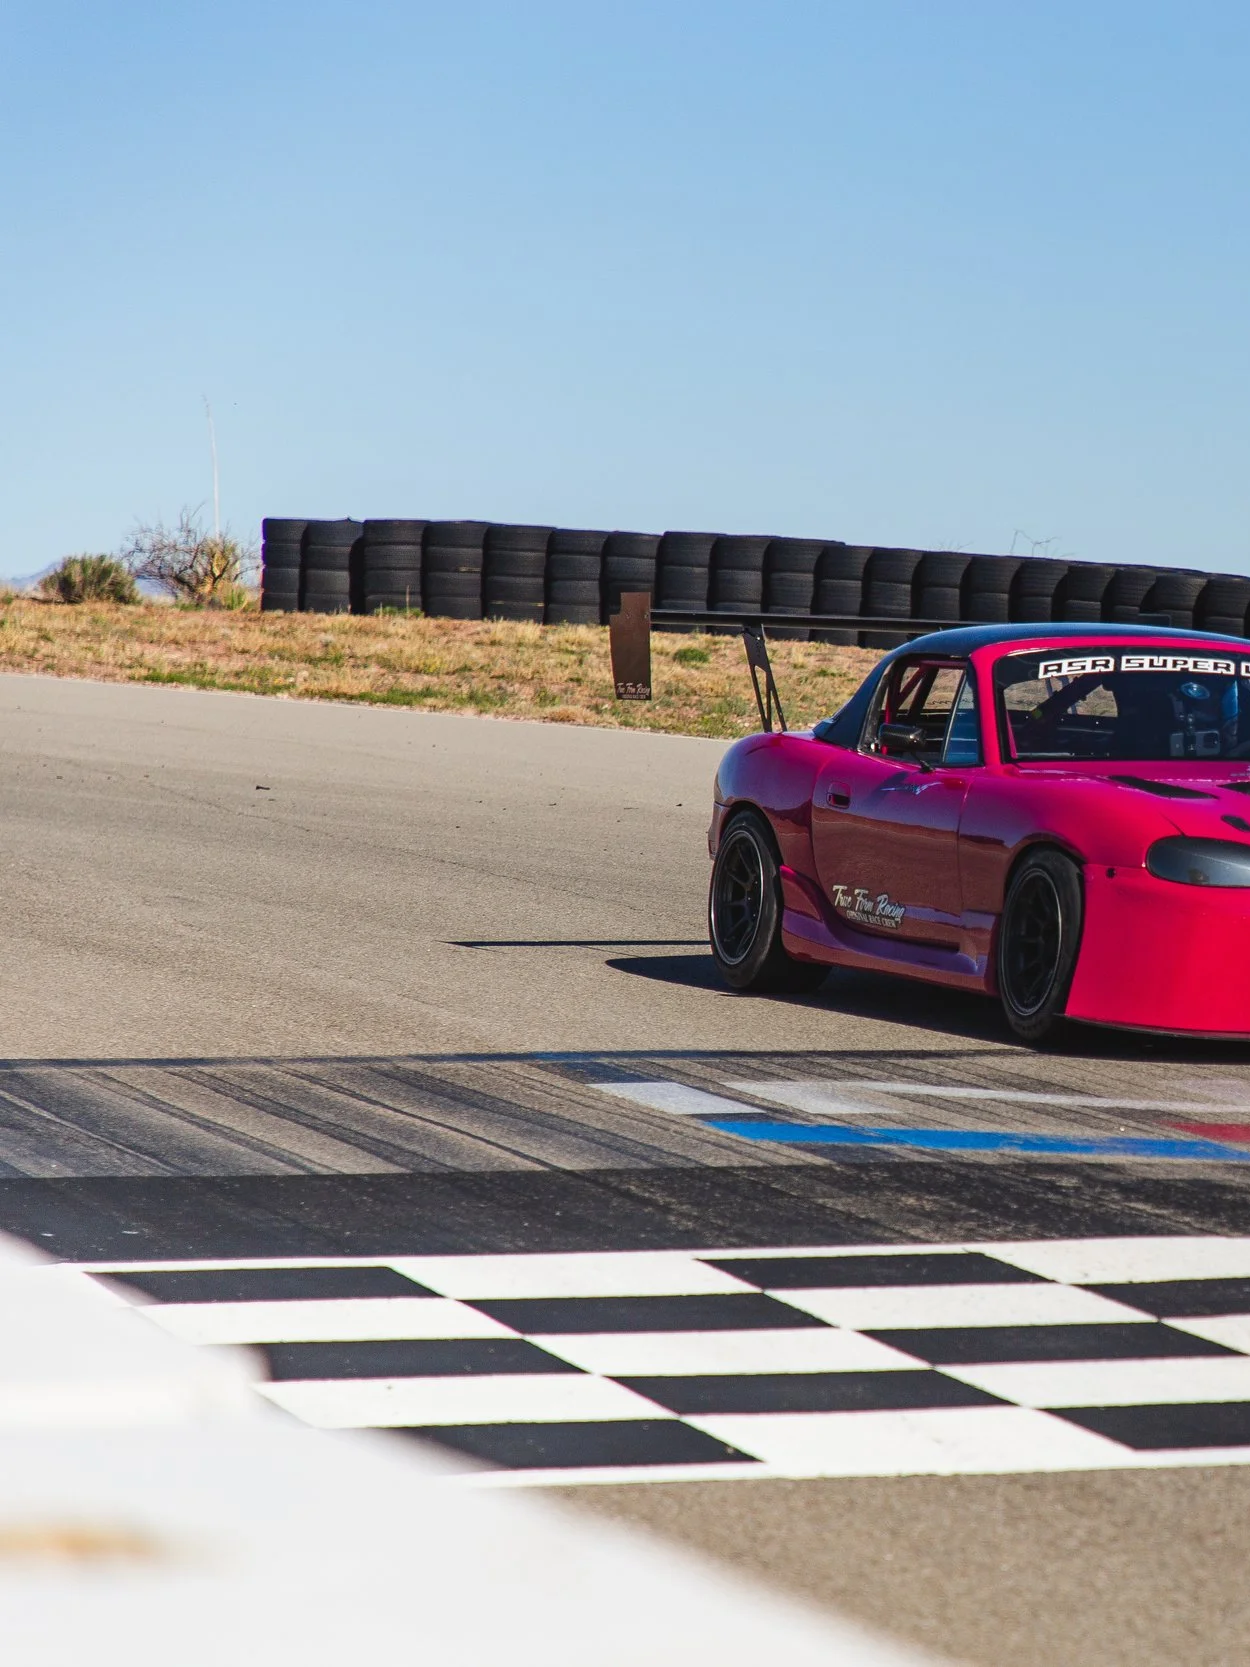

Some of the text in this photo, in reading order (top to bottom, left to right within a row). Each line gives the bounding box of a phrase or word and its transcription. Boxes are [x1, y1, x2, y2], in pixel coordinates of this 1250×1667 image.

[1038, 656, 1115, 679] ASR
[1120, 655, 1236, 676] SUPER
[832, 885, 906, 924] True Form Racing
